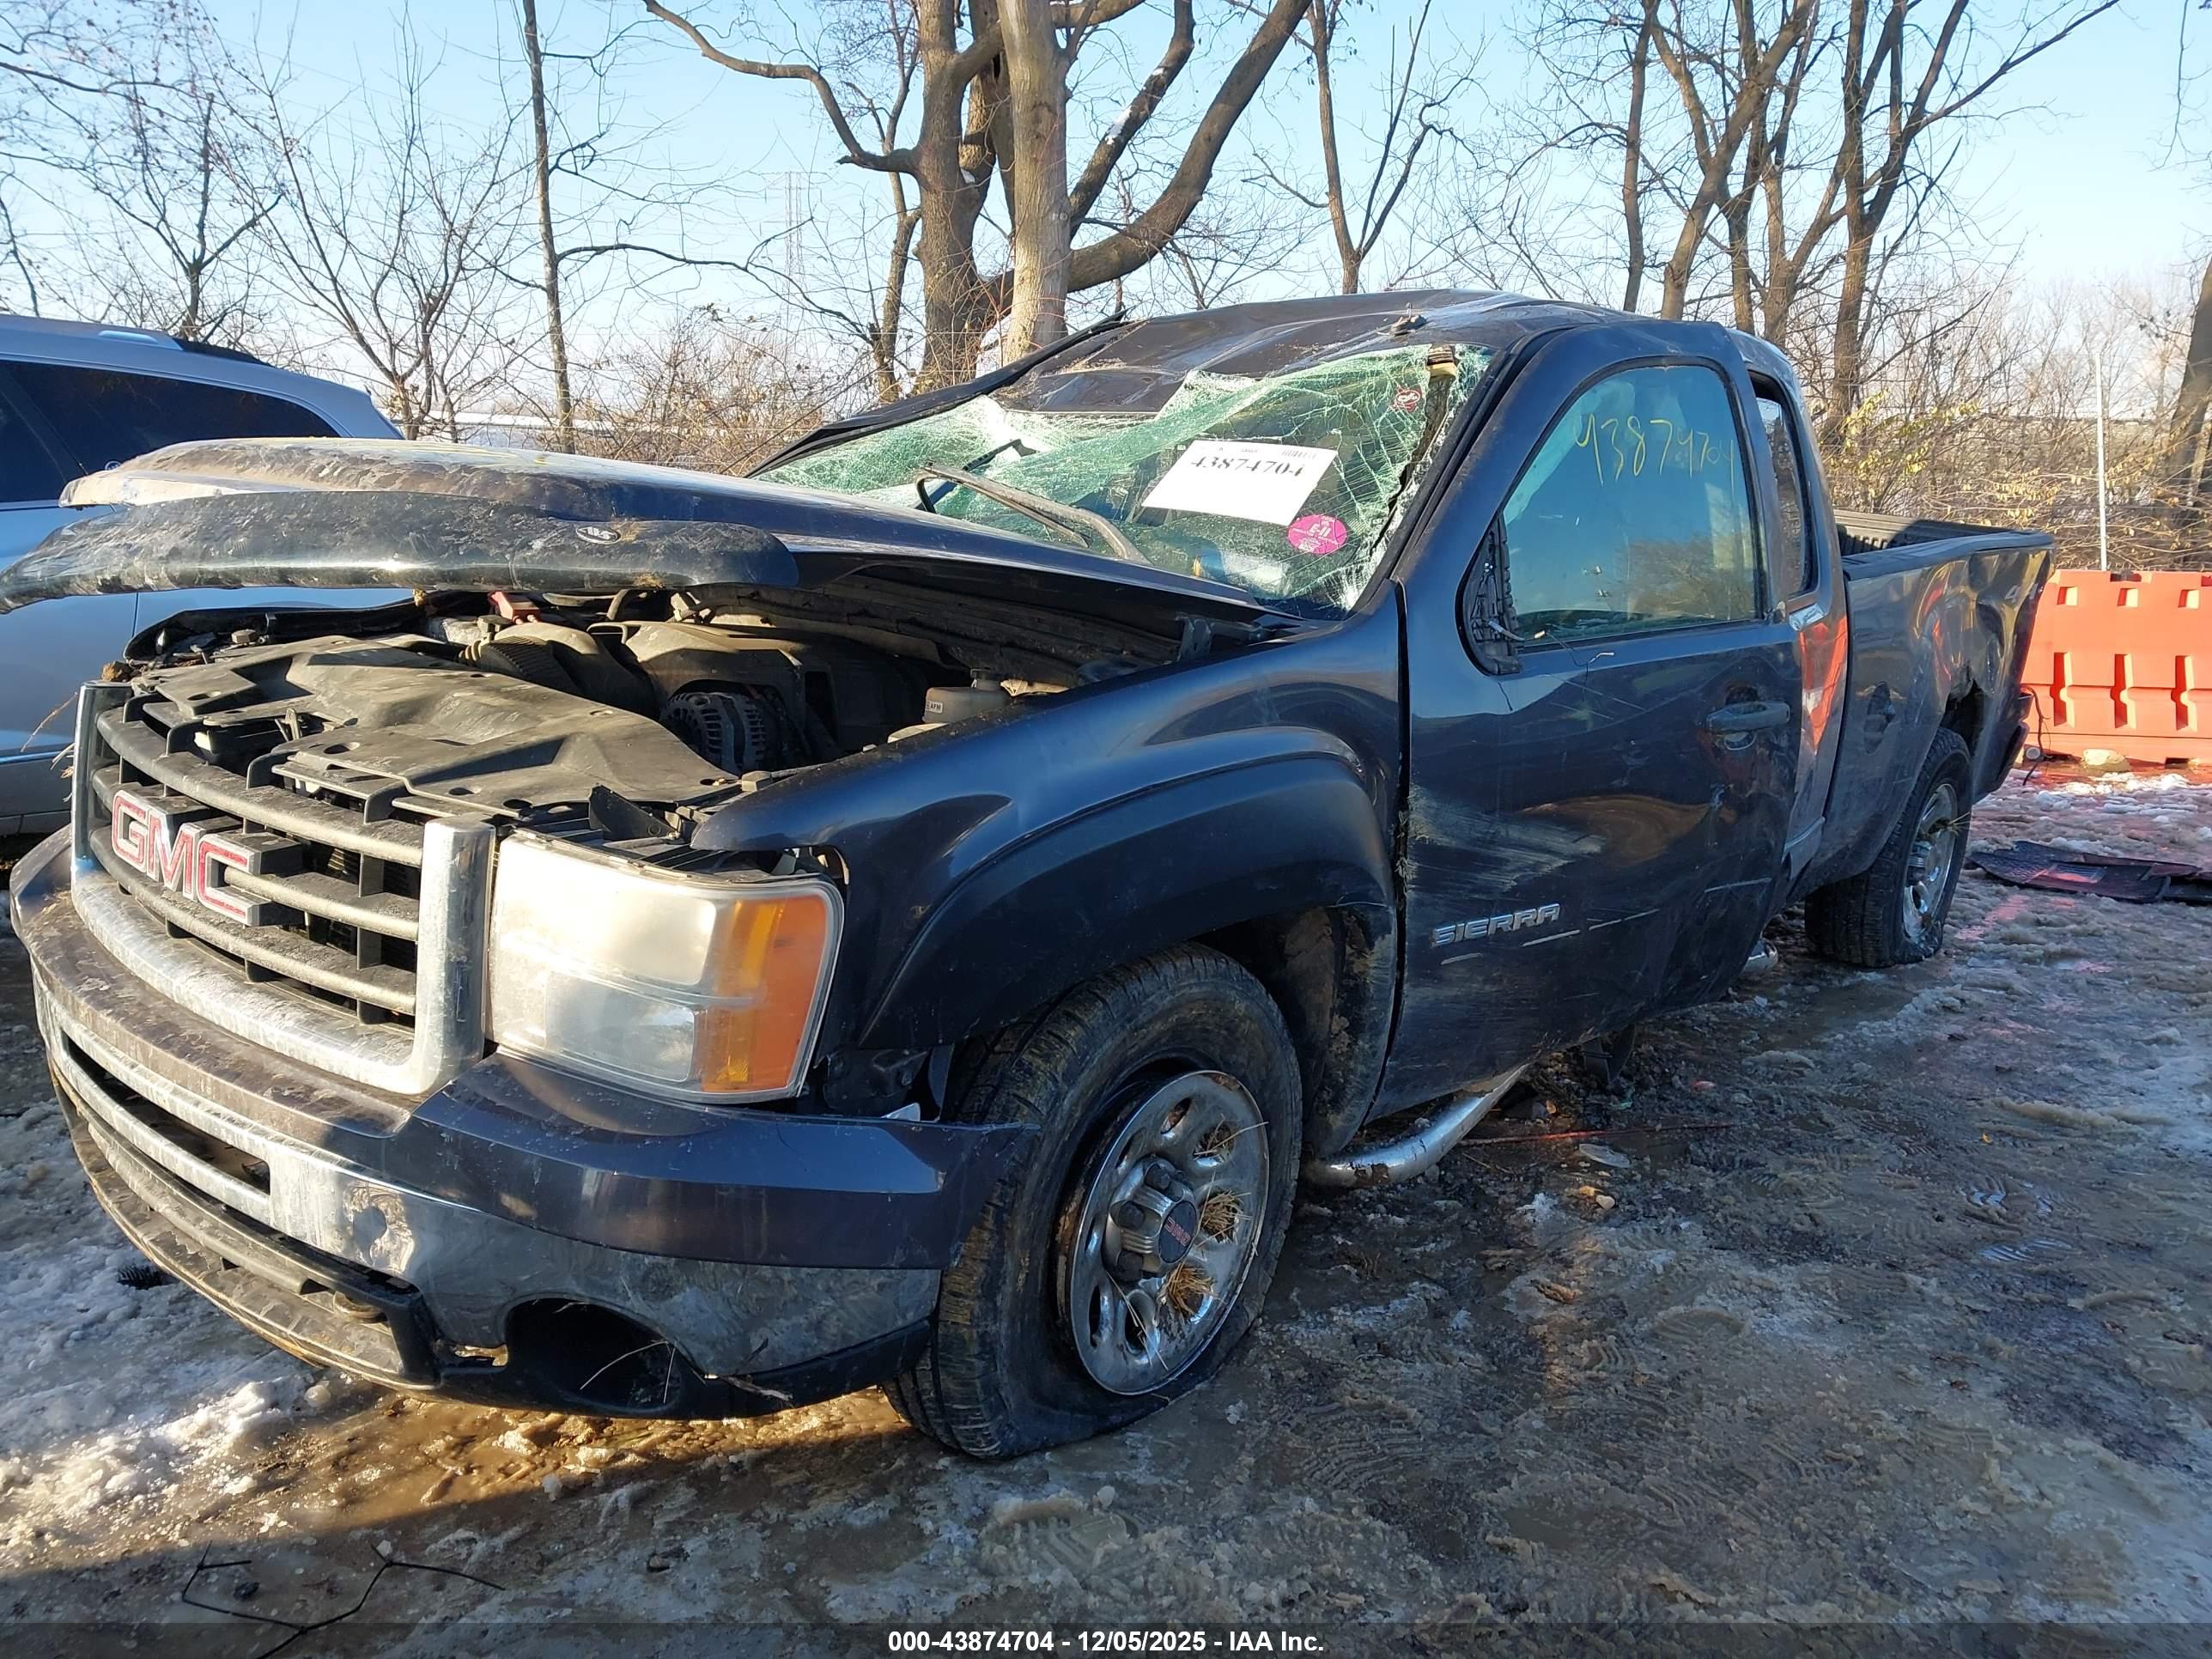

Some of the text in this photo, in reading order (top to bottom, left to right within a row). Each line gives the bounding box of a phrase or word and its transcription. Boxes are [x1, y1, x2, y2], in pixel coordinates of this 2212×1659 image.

[1191, 454, 1304, 477] 43874704
[1574, 412, 1735, 503] 43874704
[112, 789, 261, 927] GMC
[1432, 902, 1560, 947] SIERRA
